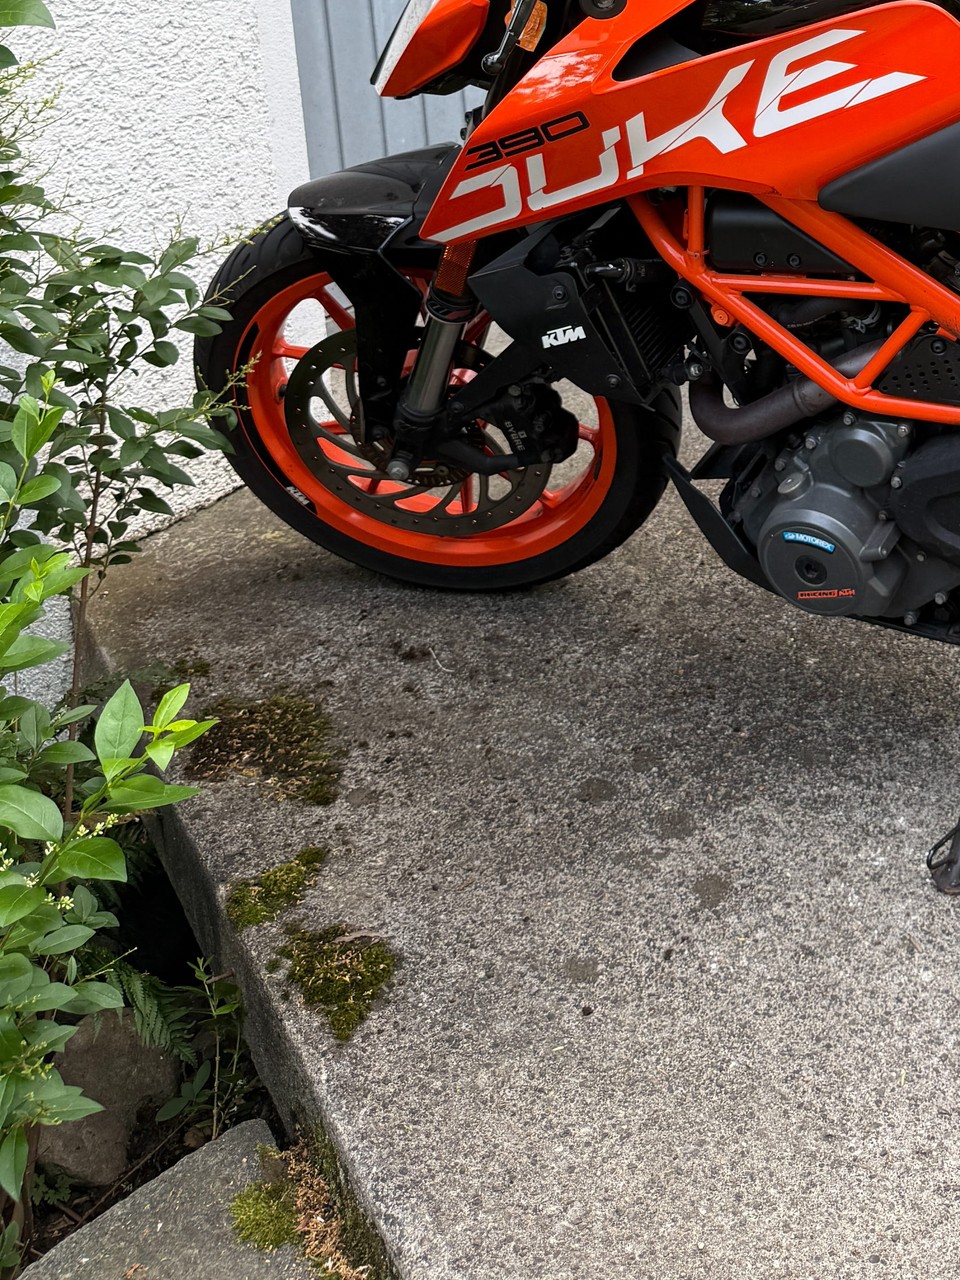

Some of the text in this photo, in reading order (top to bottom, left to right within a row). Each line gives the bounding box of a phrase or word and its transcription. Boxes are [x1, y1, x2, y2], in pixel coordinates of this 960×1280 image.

[428, 29, 928, 243] DUKE
[465, 111, 590, 170] 390
[541, 325, 586, 349] KTM
[286, 486, 310, 506] KTM
[795, 532, 834, 552] MOTOREX
